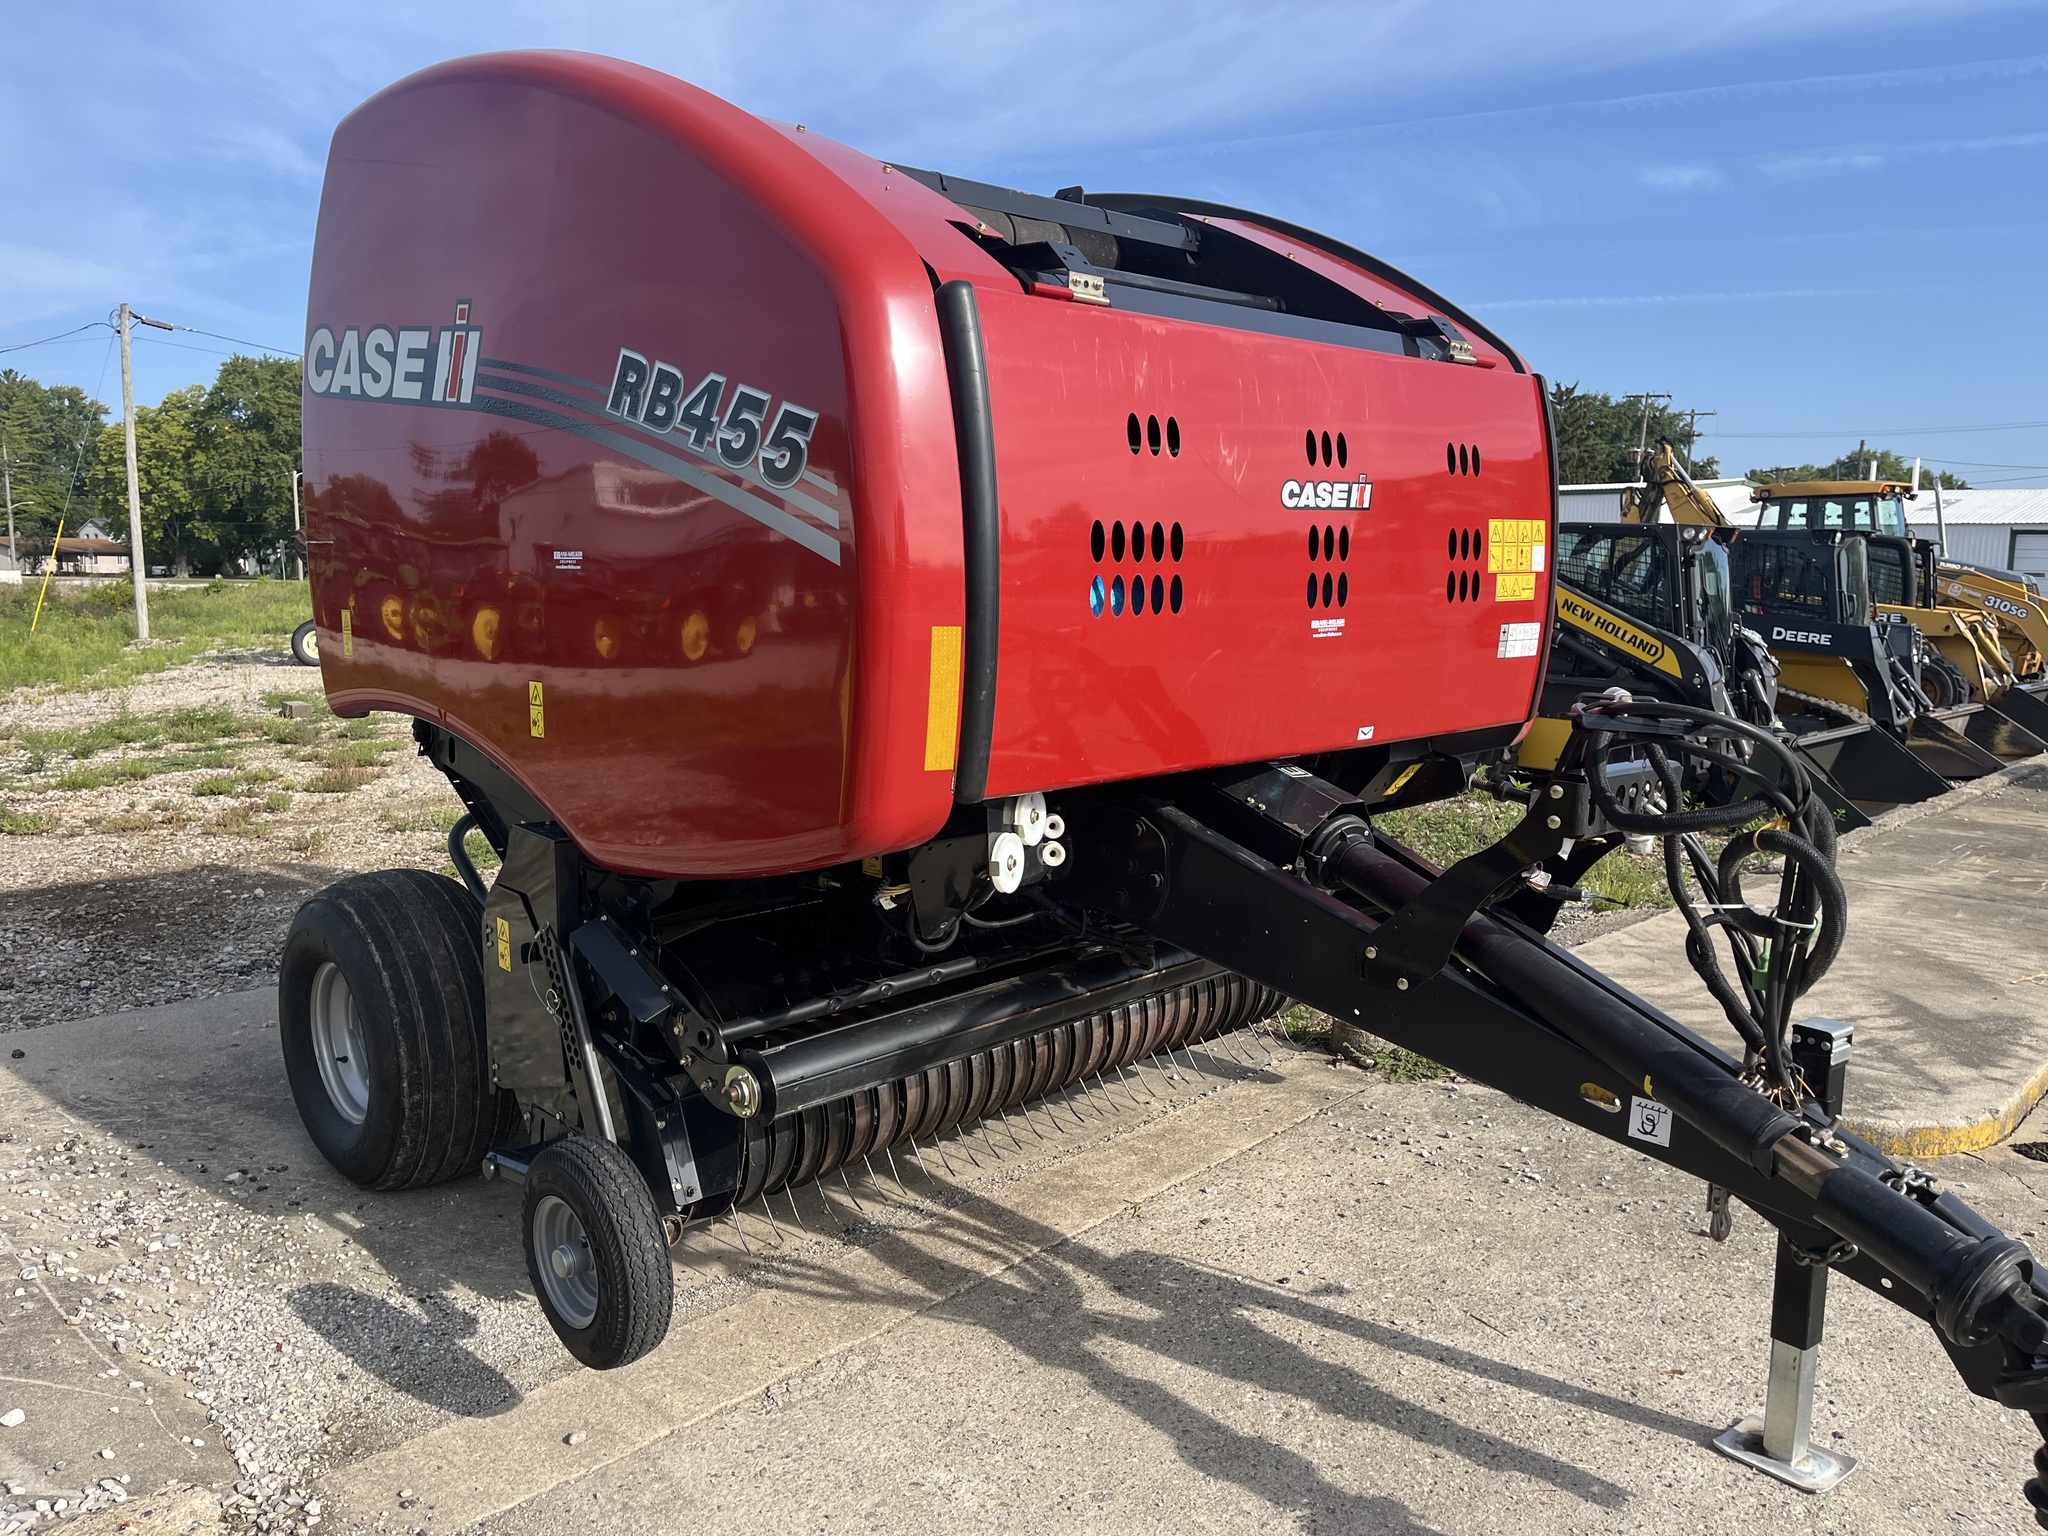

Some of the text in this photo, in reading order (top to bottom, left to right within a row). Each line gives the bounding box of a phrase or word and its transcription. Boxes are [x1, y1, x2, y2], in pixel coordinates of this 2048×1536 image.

[307, 327, 430, 400] CASE
[606, 347, 820, 490] RB455
[1281, 480, 1350, 508] CASE
[1561, 598, 1660, 657] NEW HOLLAND
[1984, 595, 2029, 619] 310SG
[1772, 626, 1833, 646] DEERE
